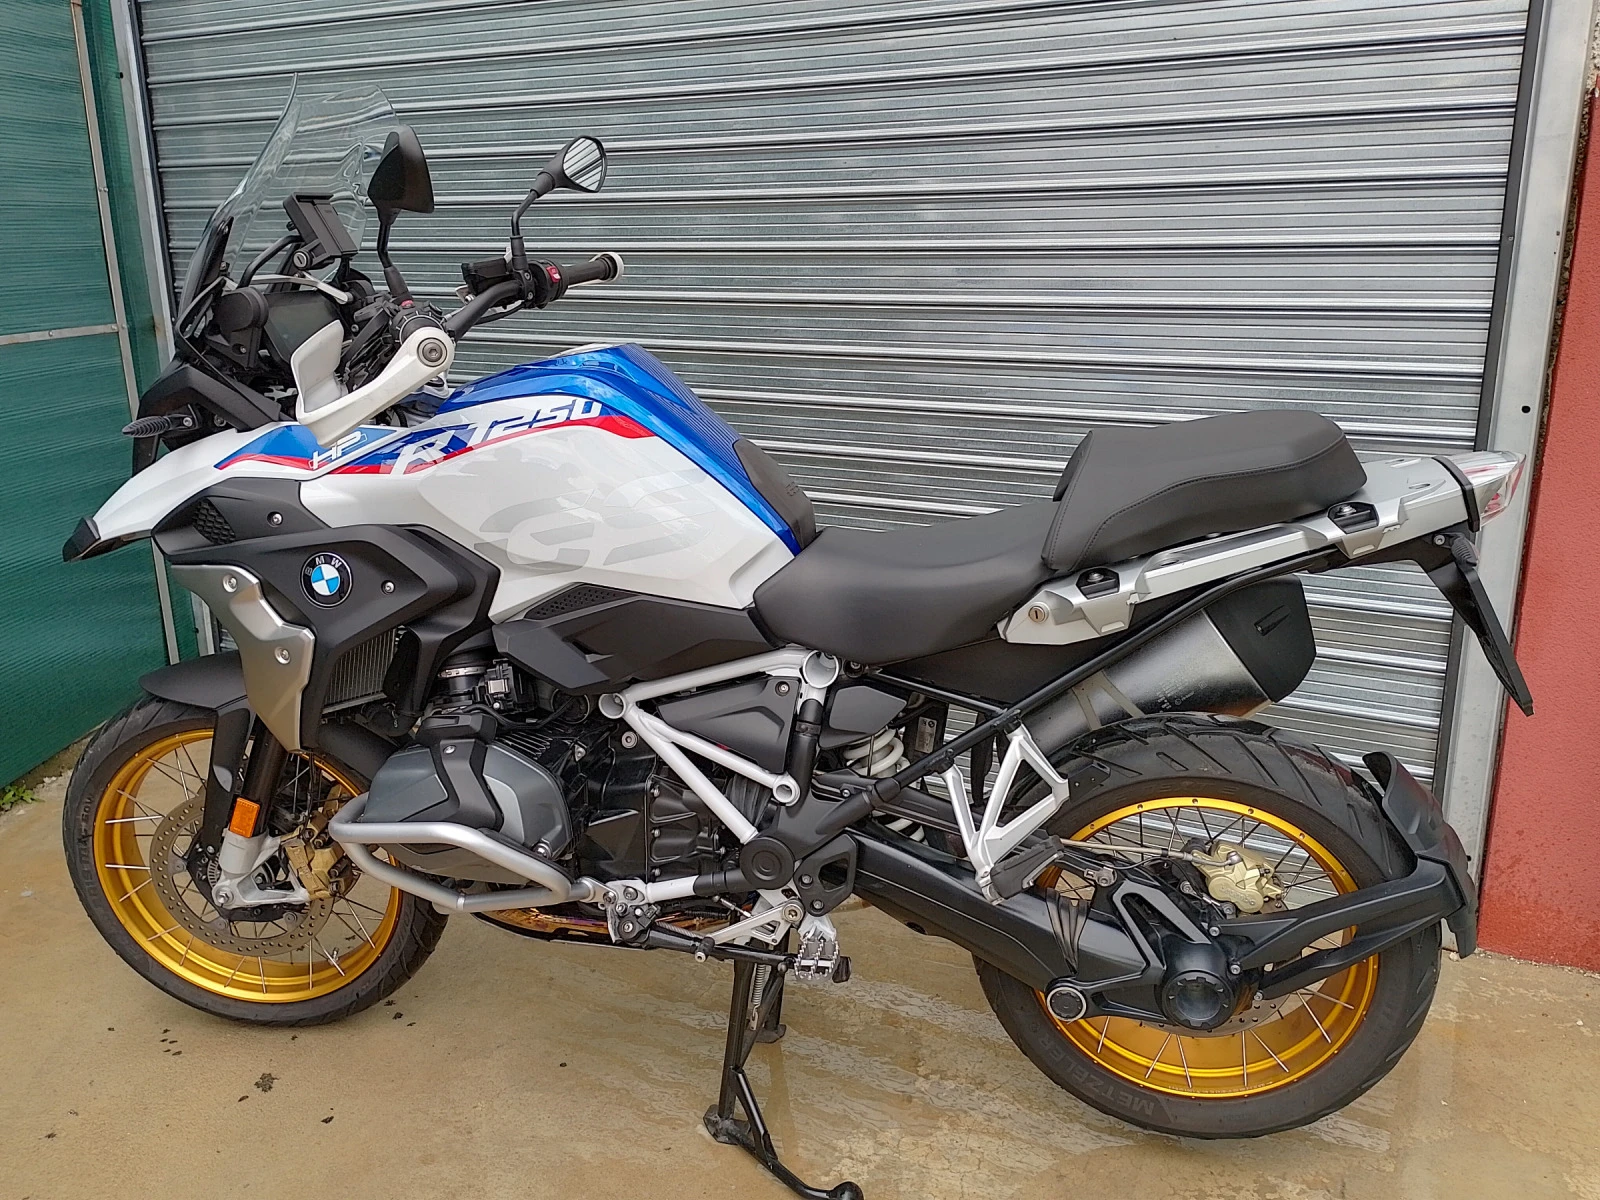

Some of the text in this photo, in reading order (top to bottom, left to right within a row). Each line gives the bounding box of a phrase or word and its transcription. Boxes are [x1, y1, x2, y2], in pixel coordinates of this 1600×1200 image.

[312, 430, 362, 470] HP
[304, 555, 342, 577] BMW
[1037, 1033, 1156, 1117] METZELER
